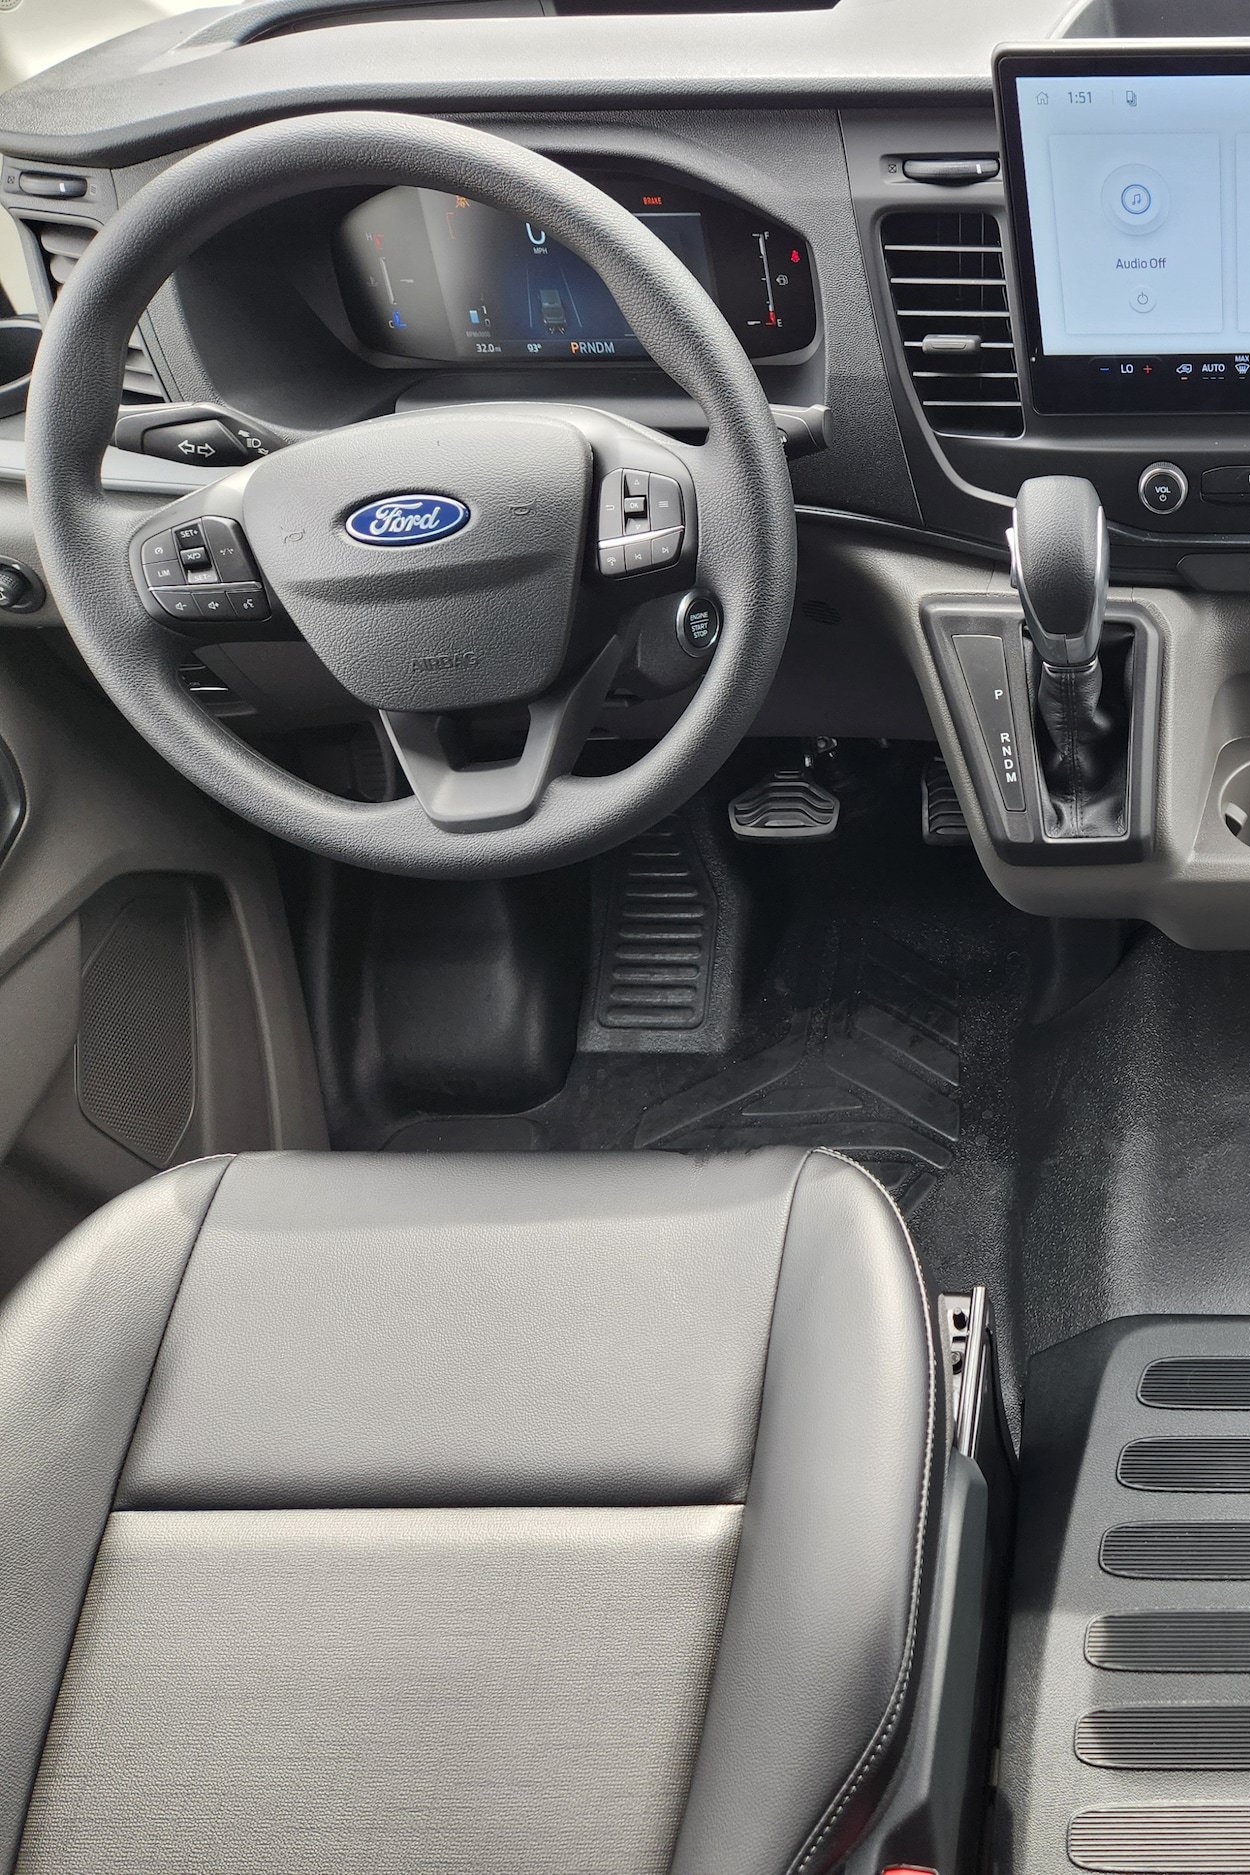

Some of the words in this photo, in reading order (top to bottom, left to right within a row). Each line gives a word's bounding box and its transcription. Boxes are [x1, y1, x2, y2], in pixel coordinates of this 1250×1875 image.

[1067, 91, 1093, 104] 1:51
[643, 196, 663, 205] BRAKE
[764, 231, 770, 240] F
[533, 246, 548, 254] MPH
[1116, 258, 1148, 269] Audio
[1149, 258, 1167, 269] Off
[777, 318, 783, 327] E
[1235, 355, 1249, 363] MAX
[1120, 364, 1134, 374] LO
[1202, 363, 1226, 372] AUTO
[1155, 486, 1171, 494] VOL
[629, 501, 639, 509] OK
[369, 502, 441, 536] Ford
[158, 569, 171, 578] LIM
[690, 611, 709, 621] ENGINE
[691, 622, 708, 632] START
[693, 629, 708, 639] STOP
[994, 689, 1003, 700] P
[1000, 732, 1011, 743] R
[1002, 746, 1012, 757] N
[1004, 759, 1014, 770] D
[1006, 772, 1017, 783] M
